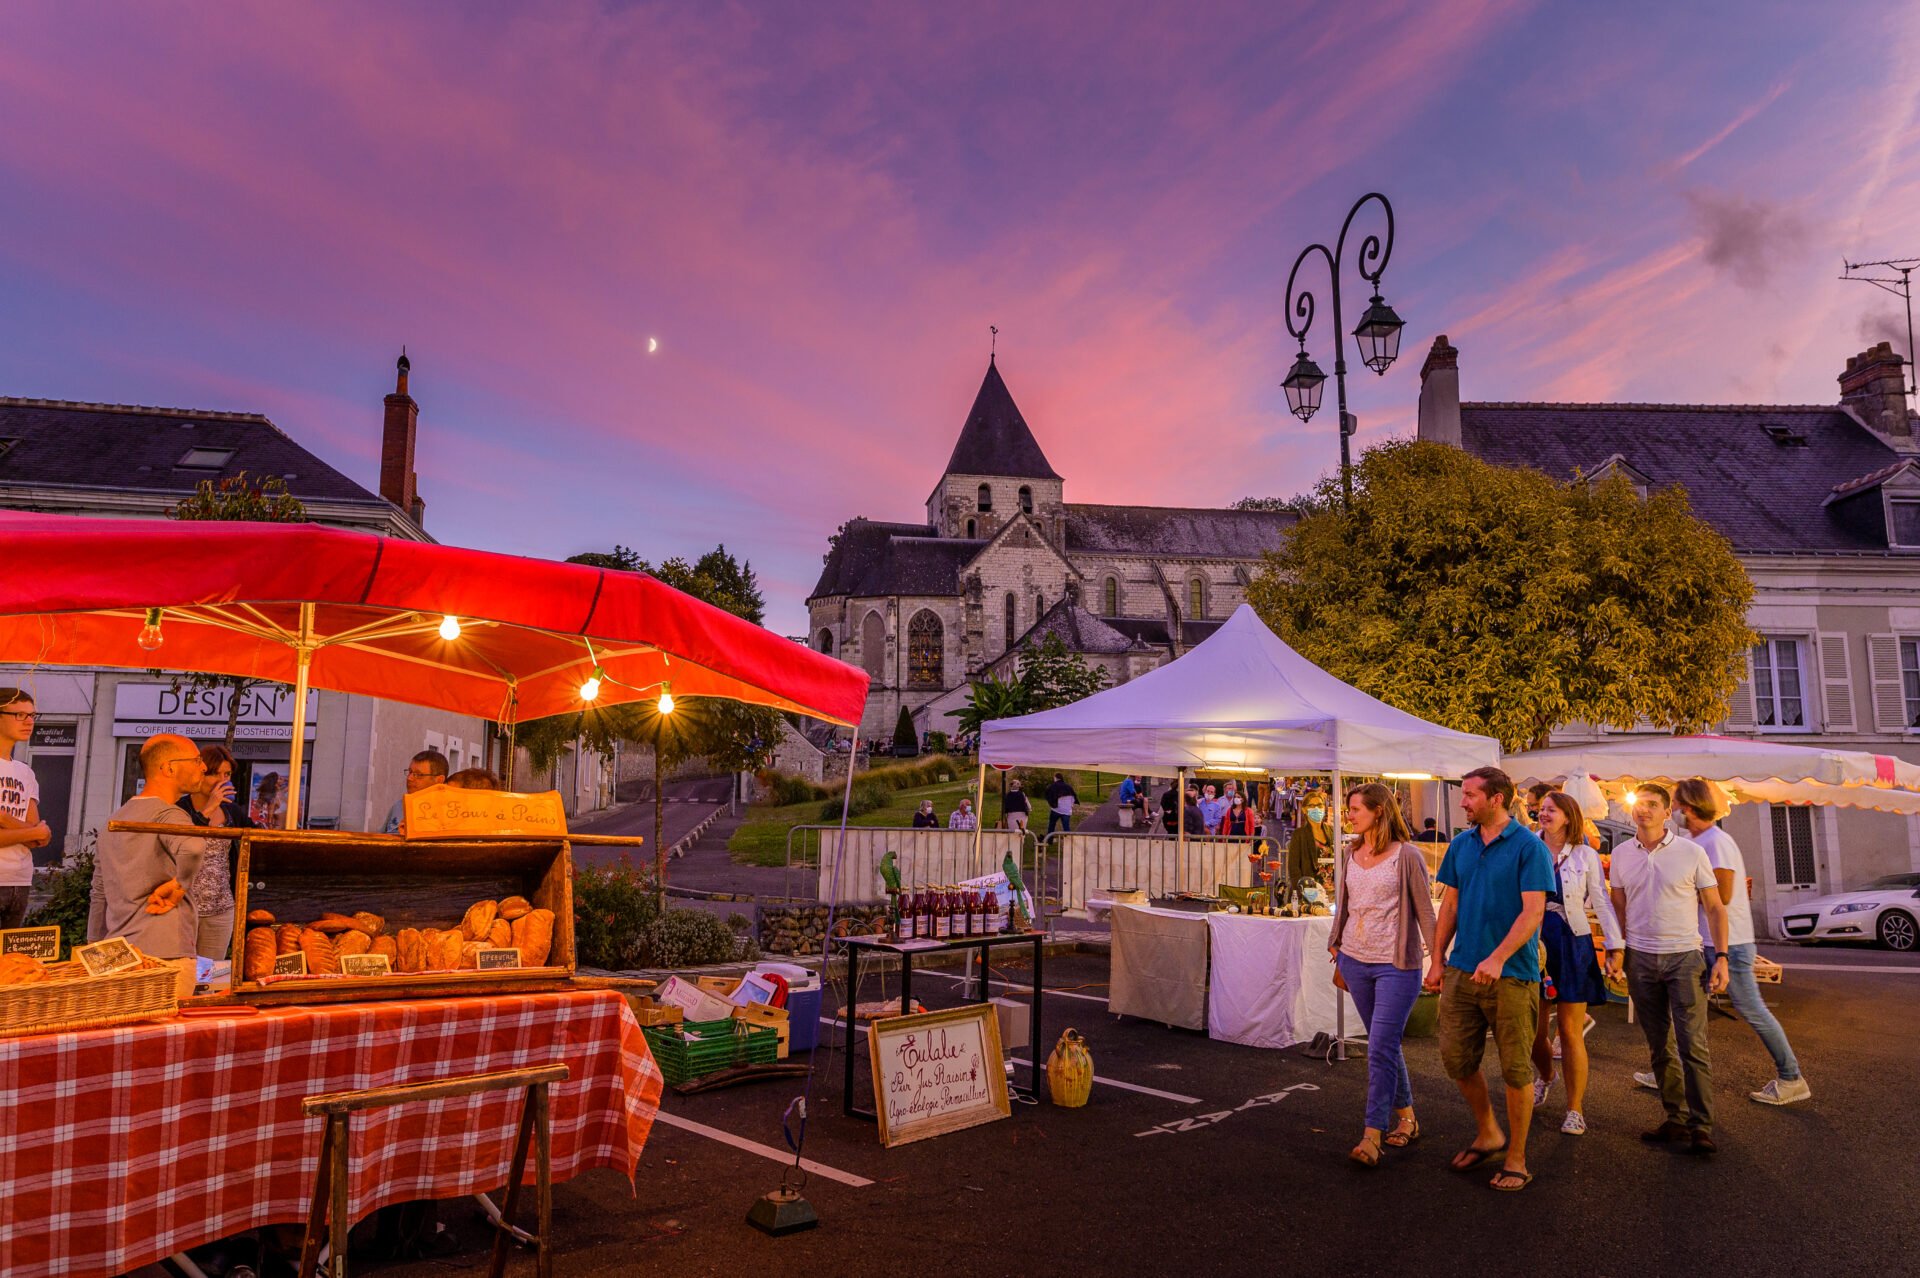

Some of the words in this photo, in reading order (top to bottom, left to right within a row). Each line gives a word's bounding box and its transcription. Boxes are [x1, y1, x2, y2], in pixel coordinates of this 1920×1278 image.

[158, 690, 278, 718] DESIGN
[36, 728, 64, 736] Institut
[185, 727, 216, 735] BEAUTE
[44, 736, 75, 745] Capillaire
[416, 801, 438, 820] Le
[446, 801, 488, 819] Four
[512, 803, 556, 825] Pains
[7, 943, 42, 953] chocolat
[891, 1071, 911, 1093] Pur
[934, 1063, 970, 1086] Raisin
[1133, 1083, 1321, 1138] PAYANT
